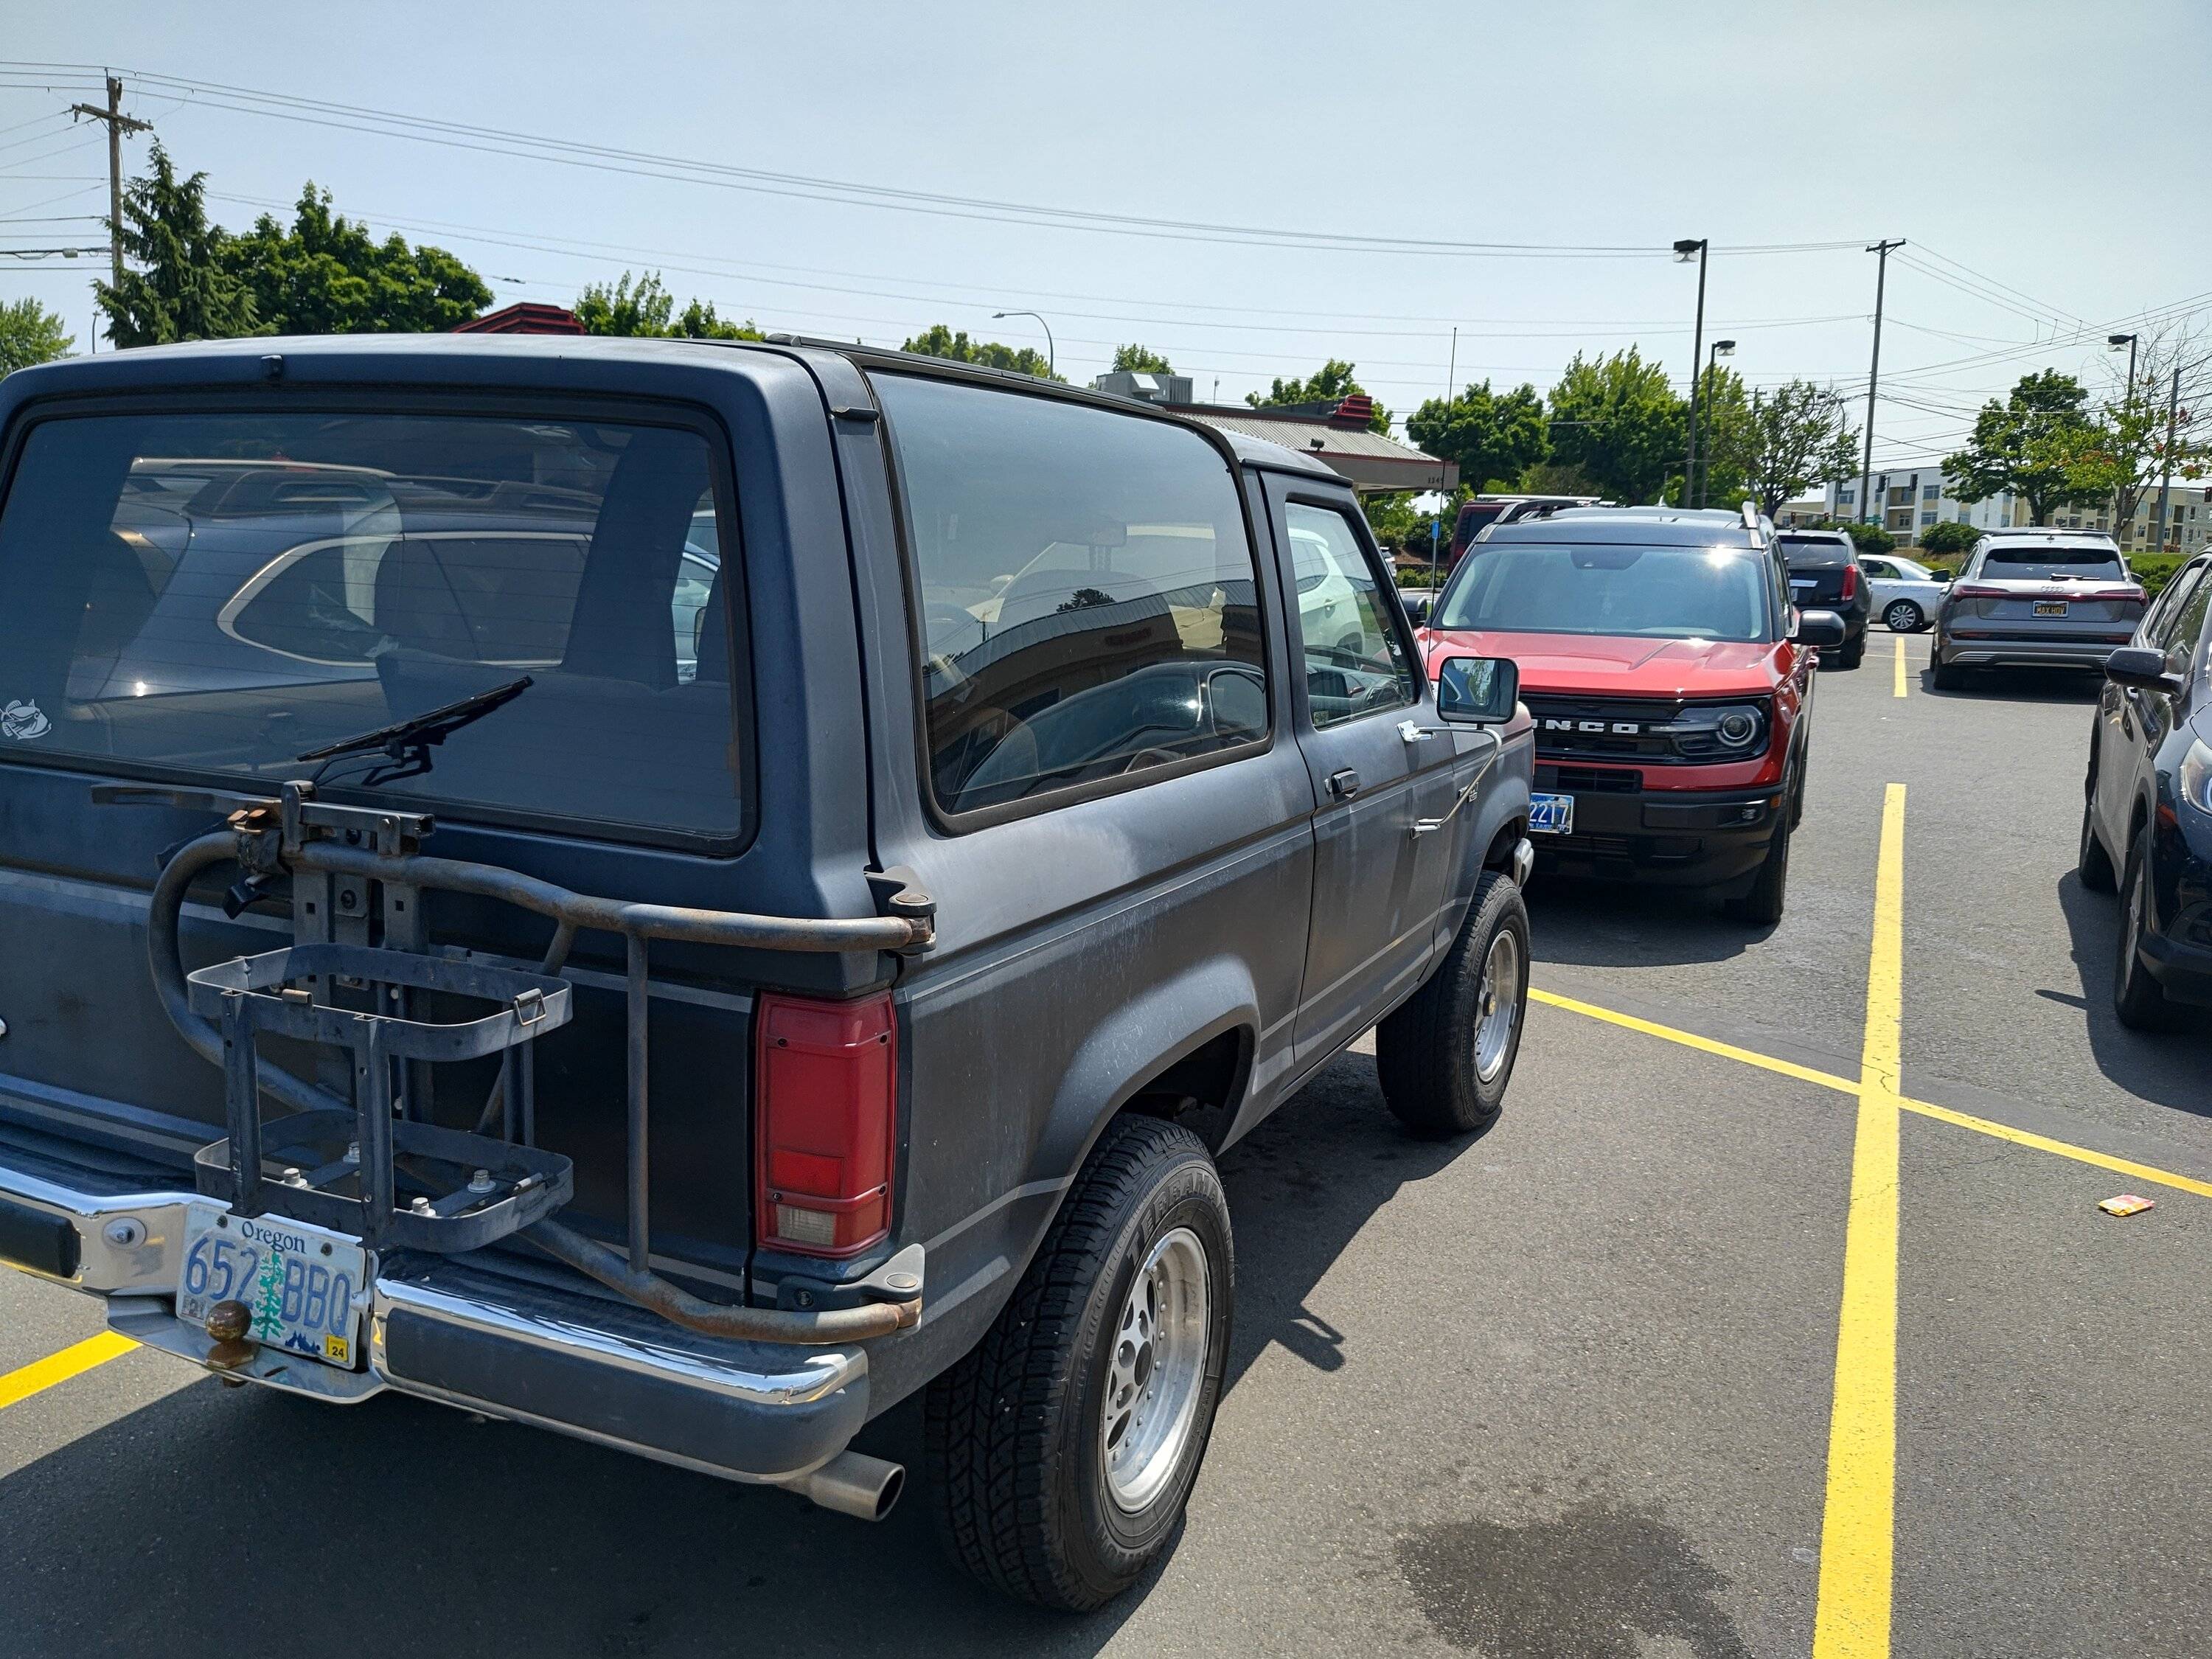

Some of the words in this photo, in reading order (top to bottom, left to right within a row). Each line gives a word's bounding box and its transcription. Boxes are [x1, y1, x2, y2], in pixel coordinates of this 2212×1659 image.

[1531, 719, 1638, 734] NCO
[1530, 802, 1568, 824] 2217
[242, 1220, 307, 1253] Oregon
[185, 1237, 259, 1310] 652
[332, 1346, 344, 1357] 24
